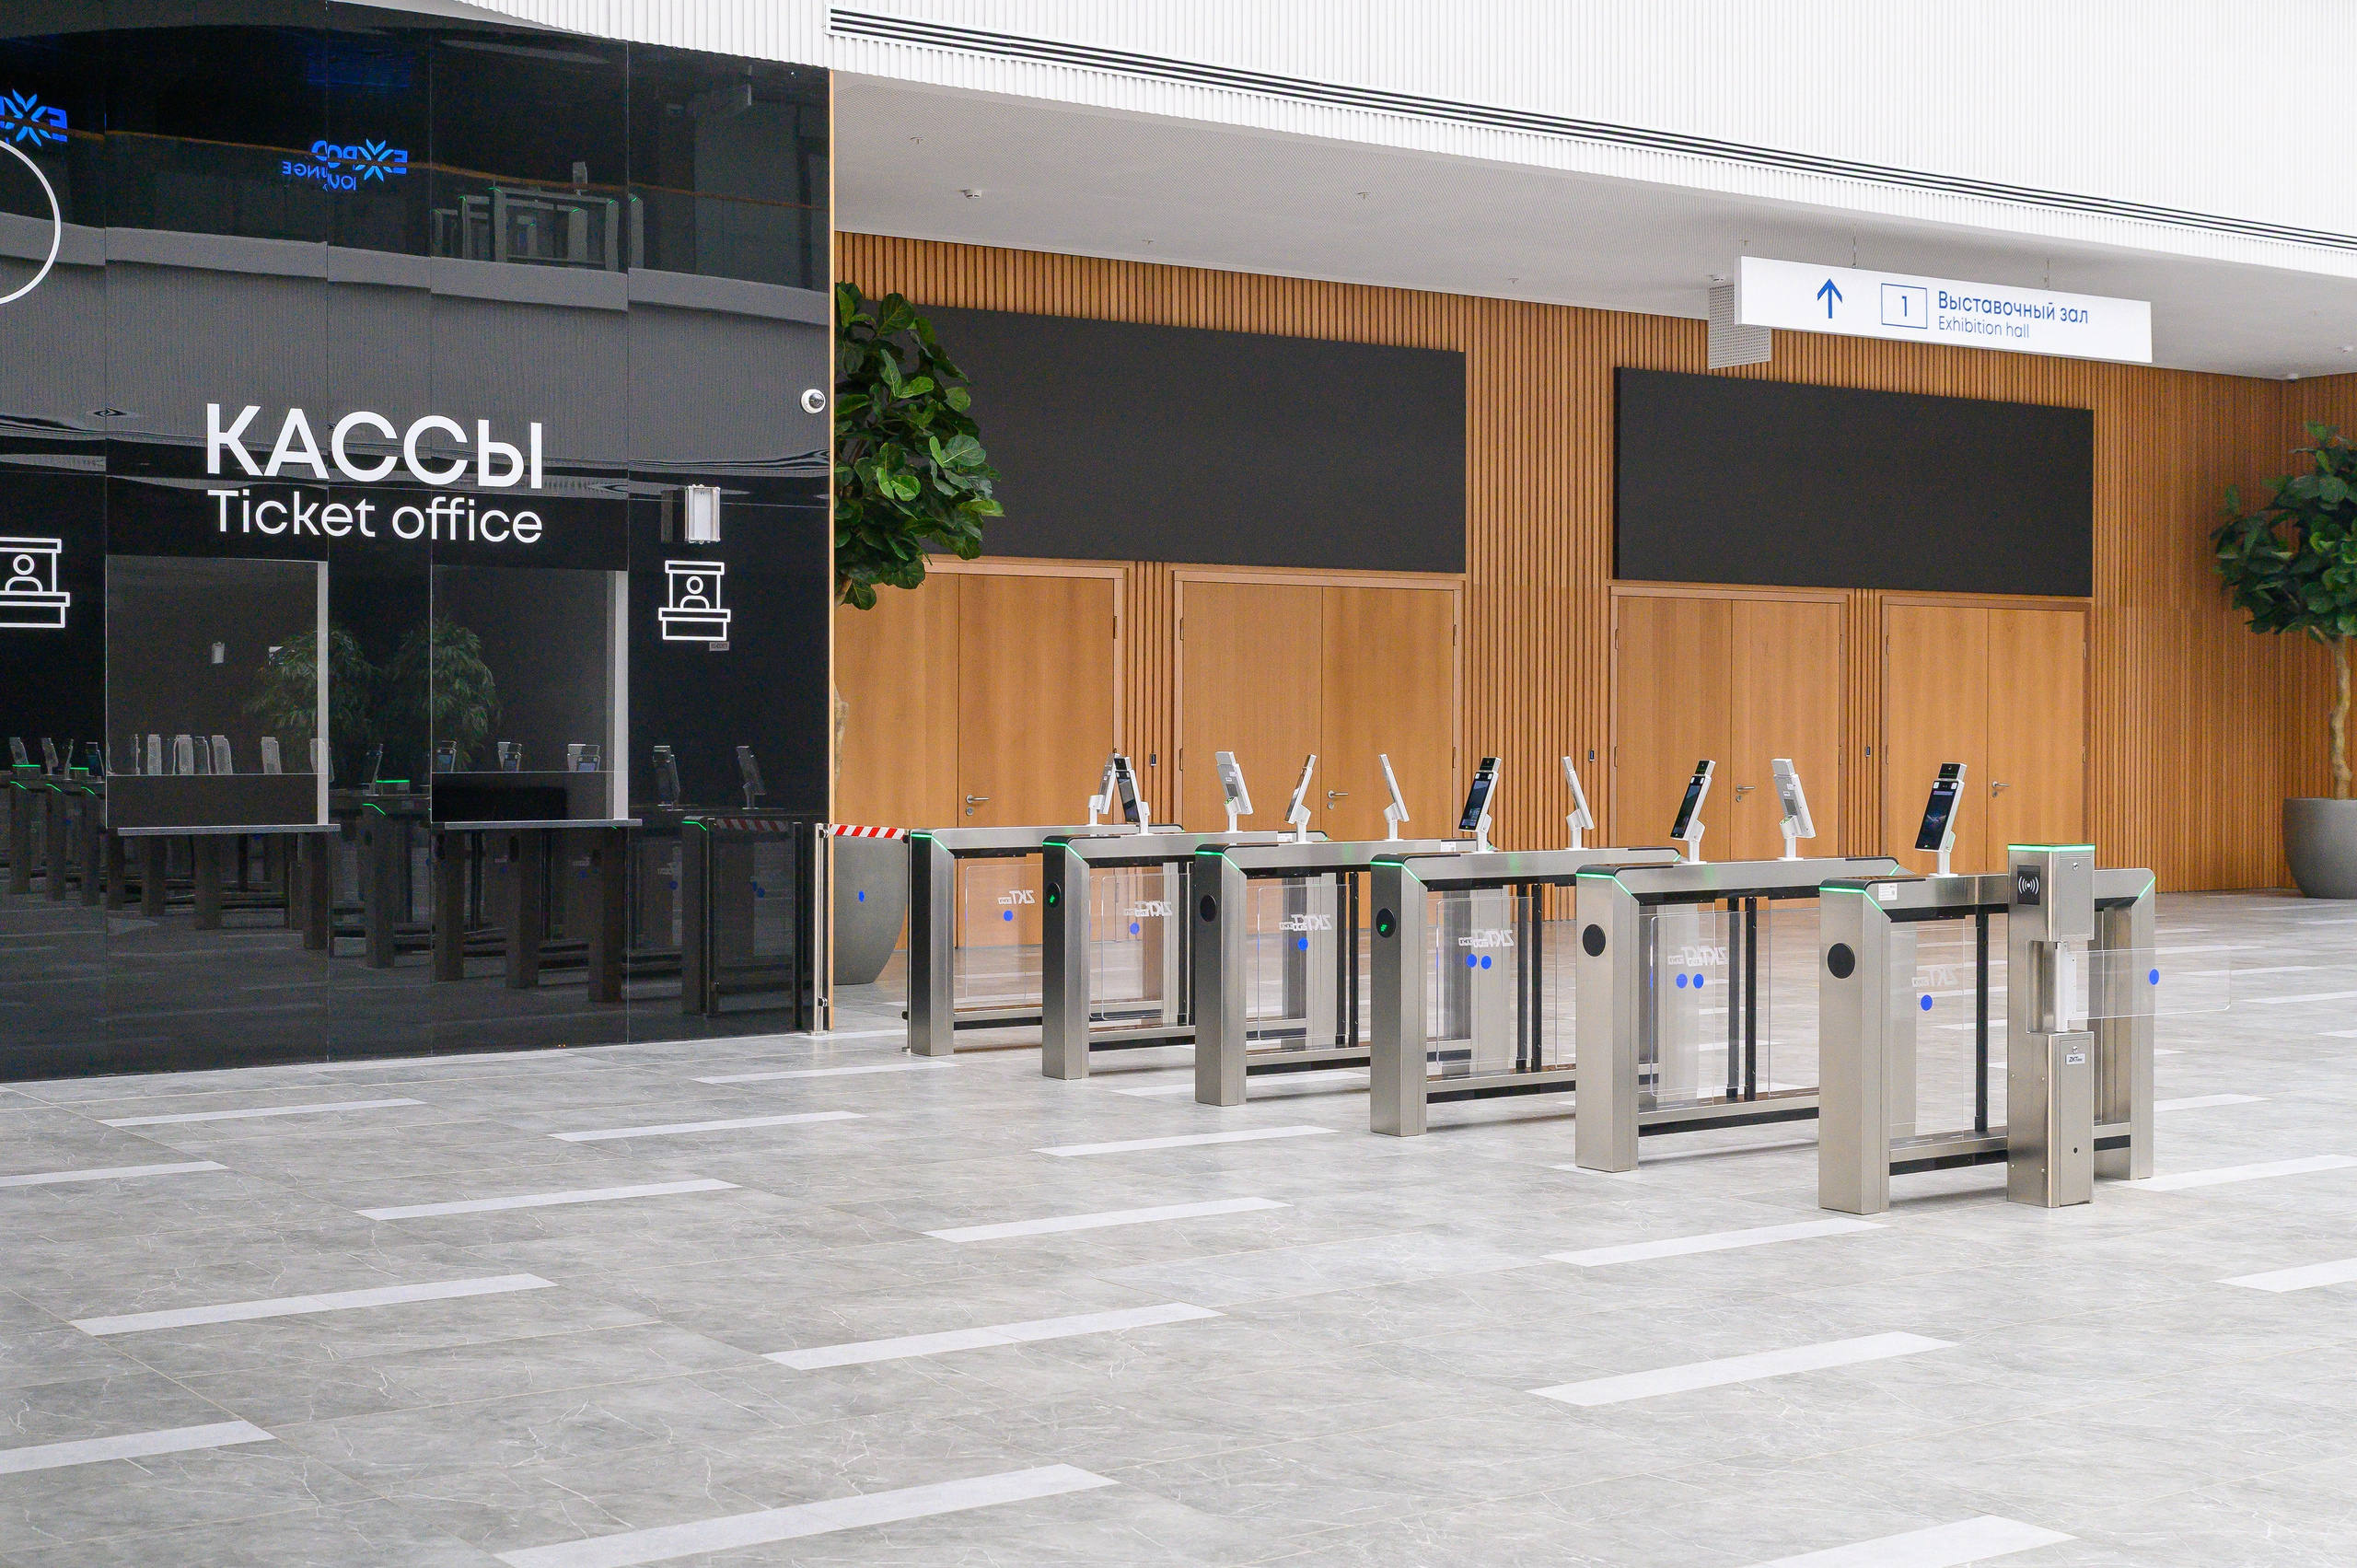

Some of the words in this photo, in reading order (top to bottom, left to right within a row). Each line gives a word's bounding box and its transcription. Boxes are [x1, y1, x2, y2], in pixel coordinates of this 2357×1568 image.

[1901, 295, 1908, 318] 1
[1938, 290, 2056, 321] Выставочный
[2060, 307, 2089, 324] зал
[1938, 315, 2003, 336] Exhibition
[2005, 321, 2030, 339] hall
[206, 402, 543, 490] КАССЫ
[207, 489, 377, 538] Ticket
[391, 495, 543, 543] office
